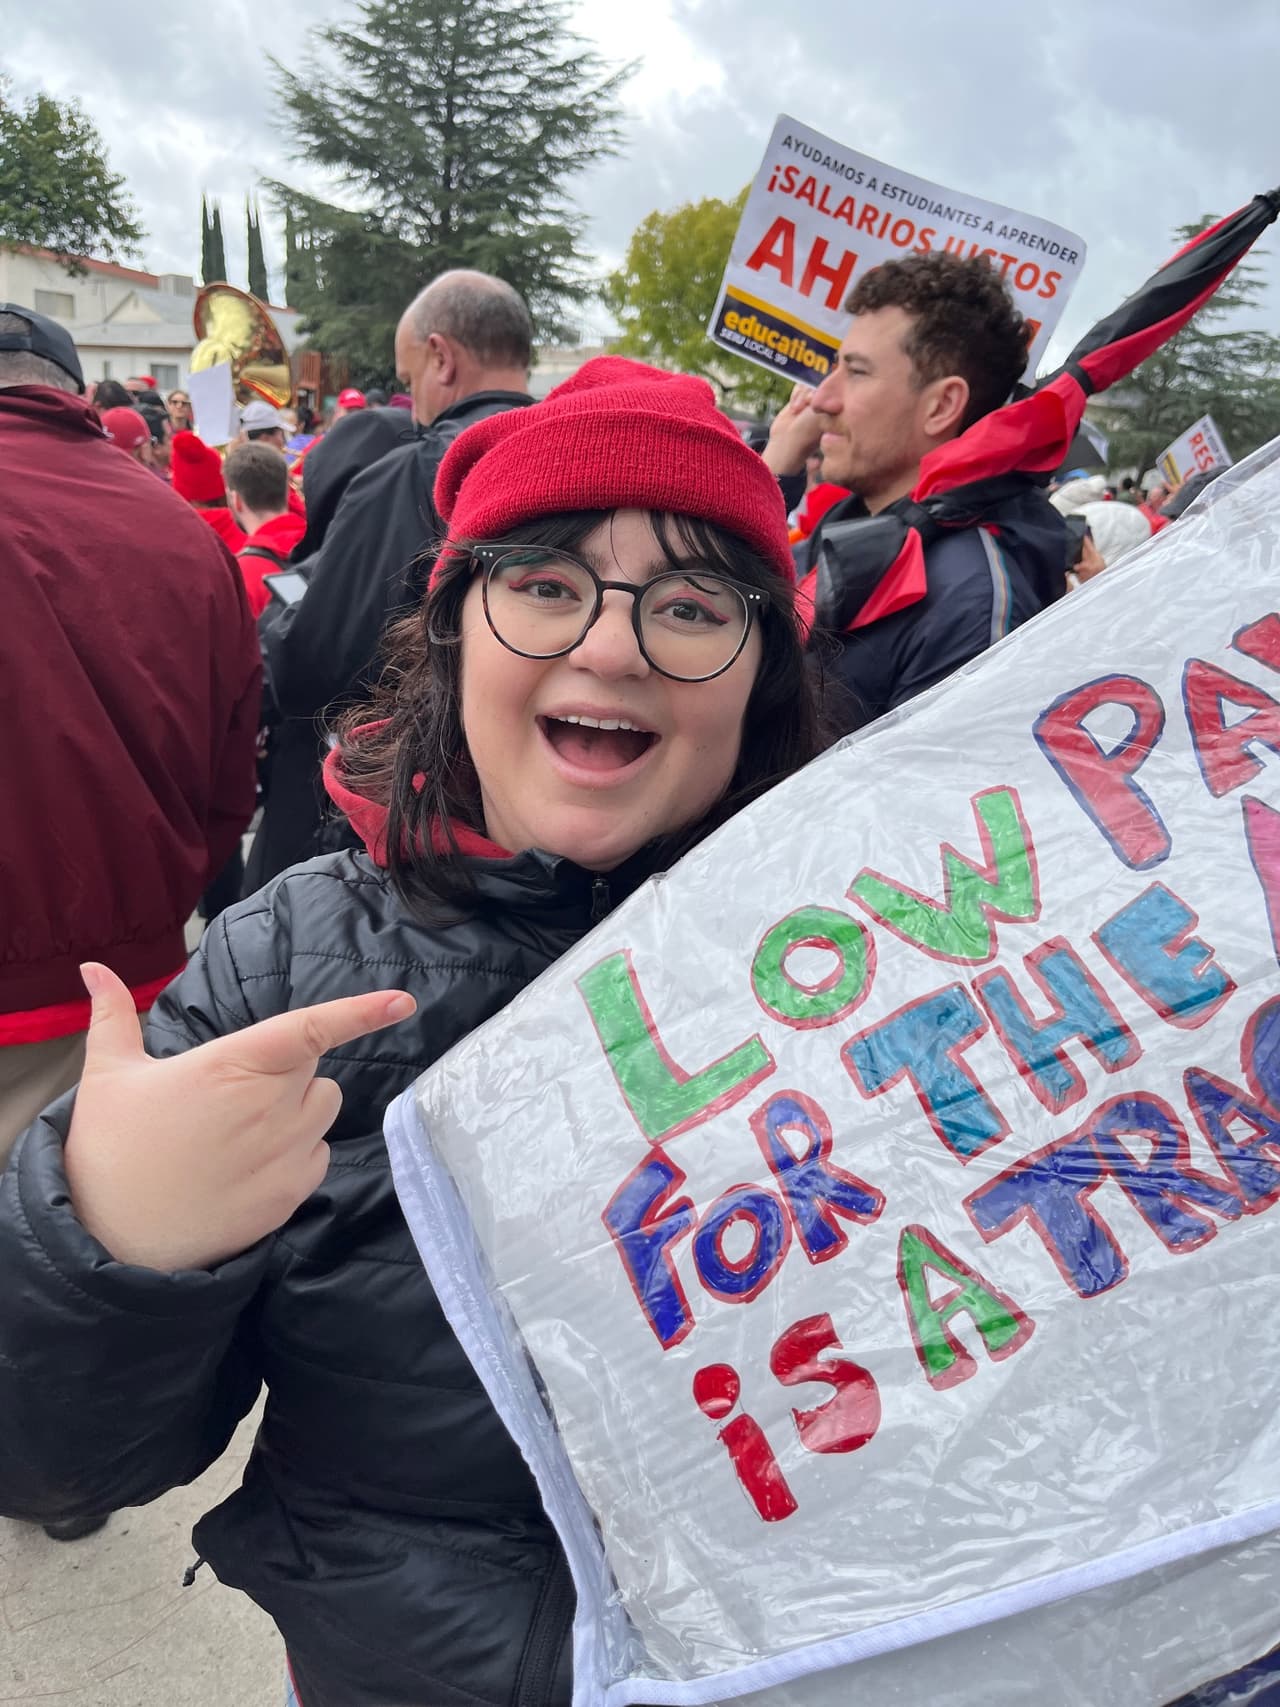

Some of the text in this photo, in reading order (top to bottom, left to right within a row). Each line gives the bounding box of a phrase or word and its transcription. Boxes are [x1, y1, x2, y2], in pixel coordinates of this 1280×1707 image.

[766, 164, 937, 255] ¡SALARIOS
[944, 235, 1063, 299] TOS
[782, 135, 1079, 265] AYUDAMOS A ESTUDIANTES A APRENDER
[724, 310, 829, 375] education
[574, 784, 1042, 1144] LOW
[602, 881, 1238, 1350] FOR THE
[897, 1224, 1036, 1391] A
